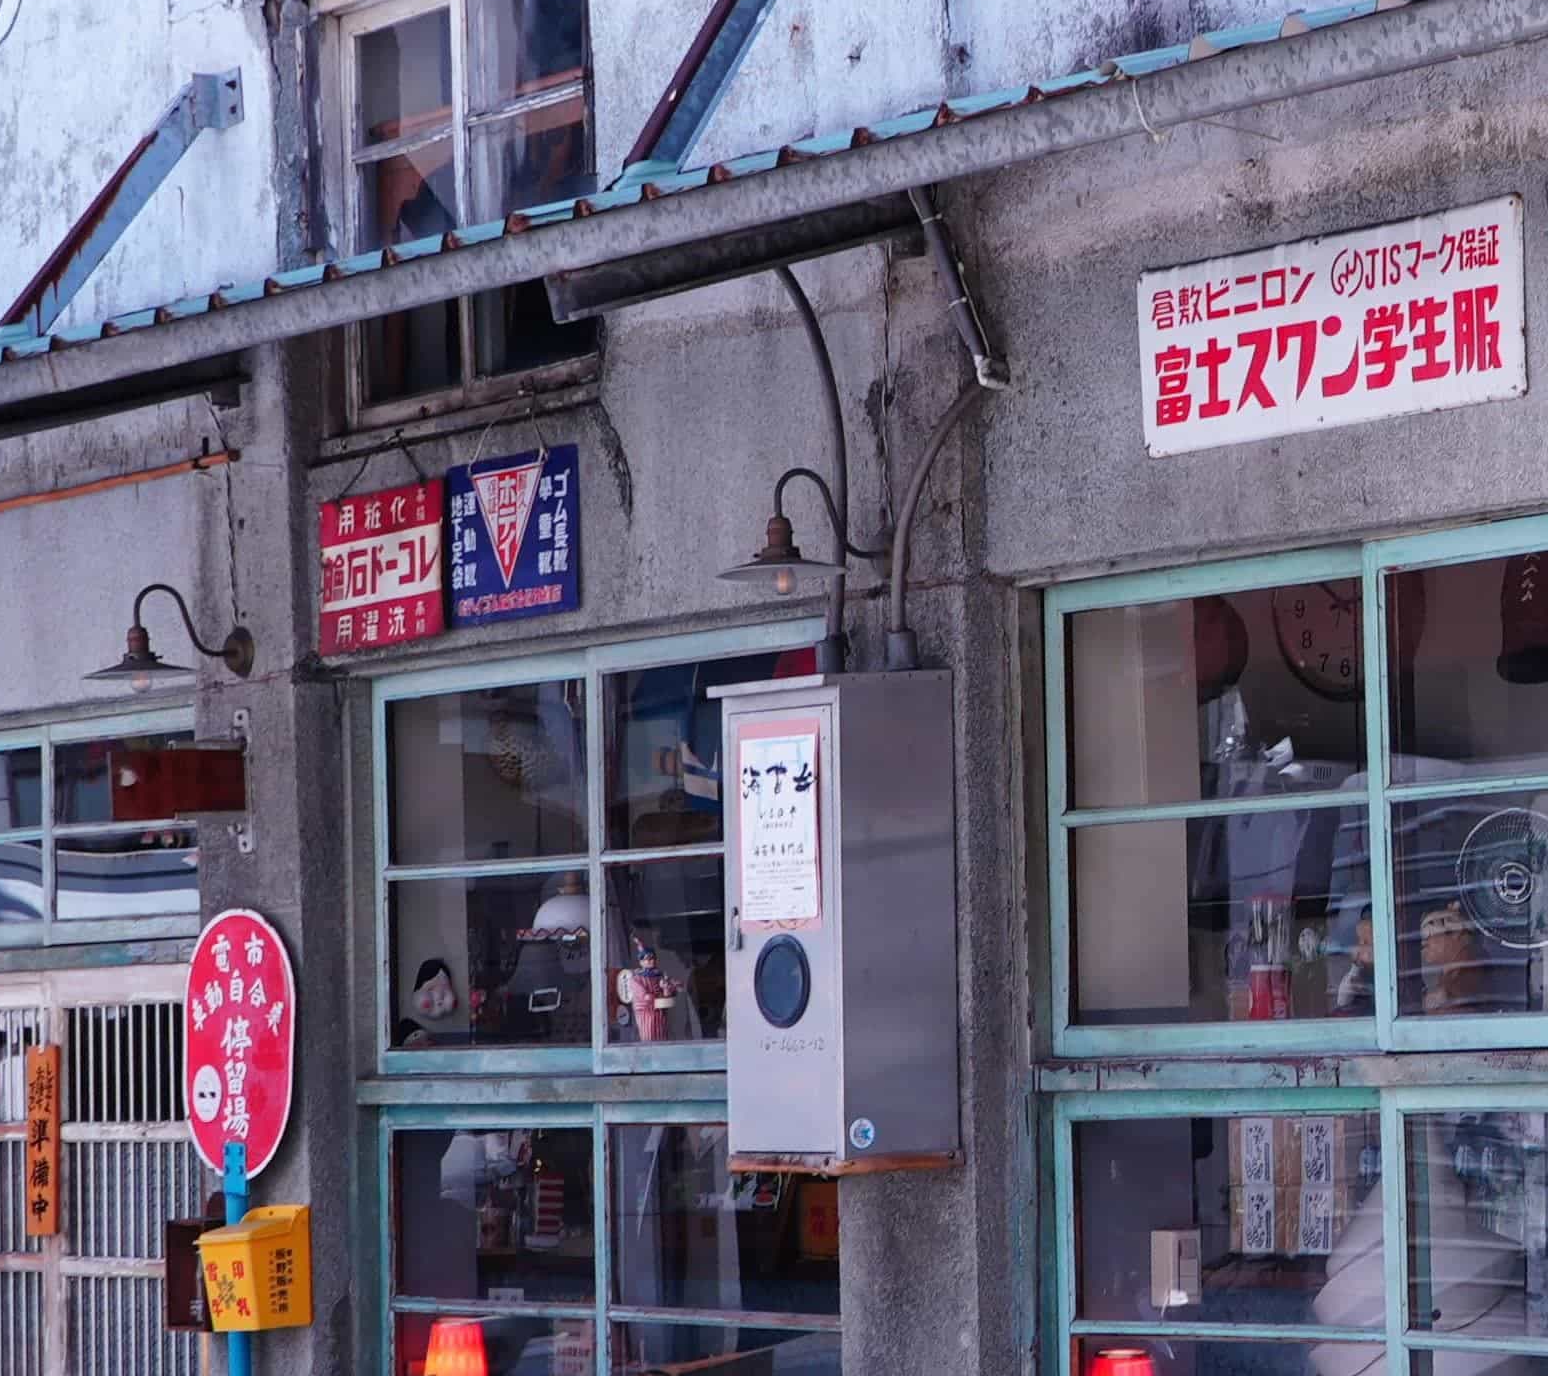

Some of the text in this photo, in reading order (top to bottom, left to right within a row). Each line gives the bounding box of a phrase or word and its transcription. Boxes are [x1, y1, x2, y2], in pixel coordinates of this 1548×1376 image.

[1365, 225, 1500, 291] JISマーク保証
[1152, 266, 1316, 330] 倉敷ビニロン
[1155, 285, 1503, 426] 富士スワン学生服
[1294, 599, 1306, 619] 9
[1301, 630, 1313, 649] 8
[1318, 653, 1331, 672] 7
[1340, 658, 1350, 677] 6
[220, 1015, 253, 1139] 停留場
[30, 1119, 51, 1223] 準備中
